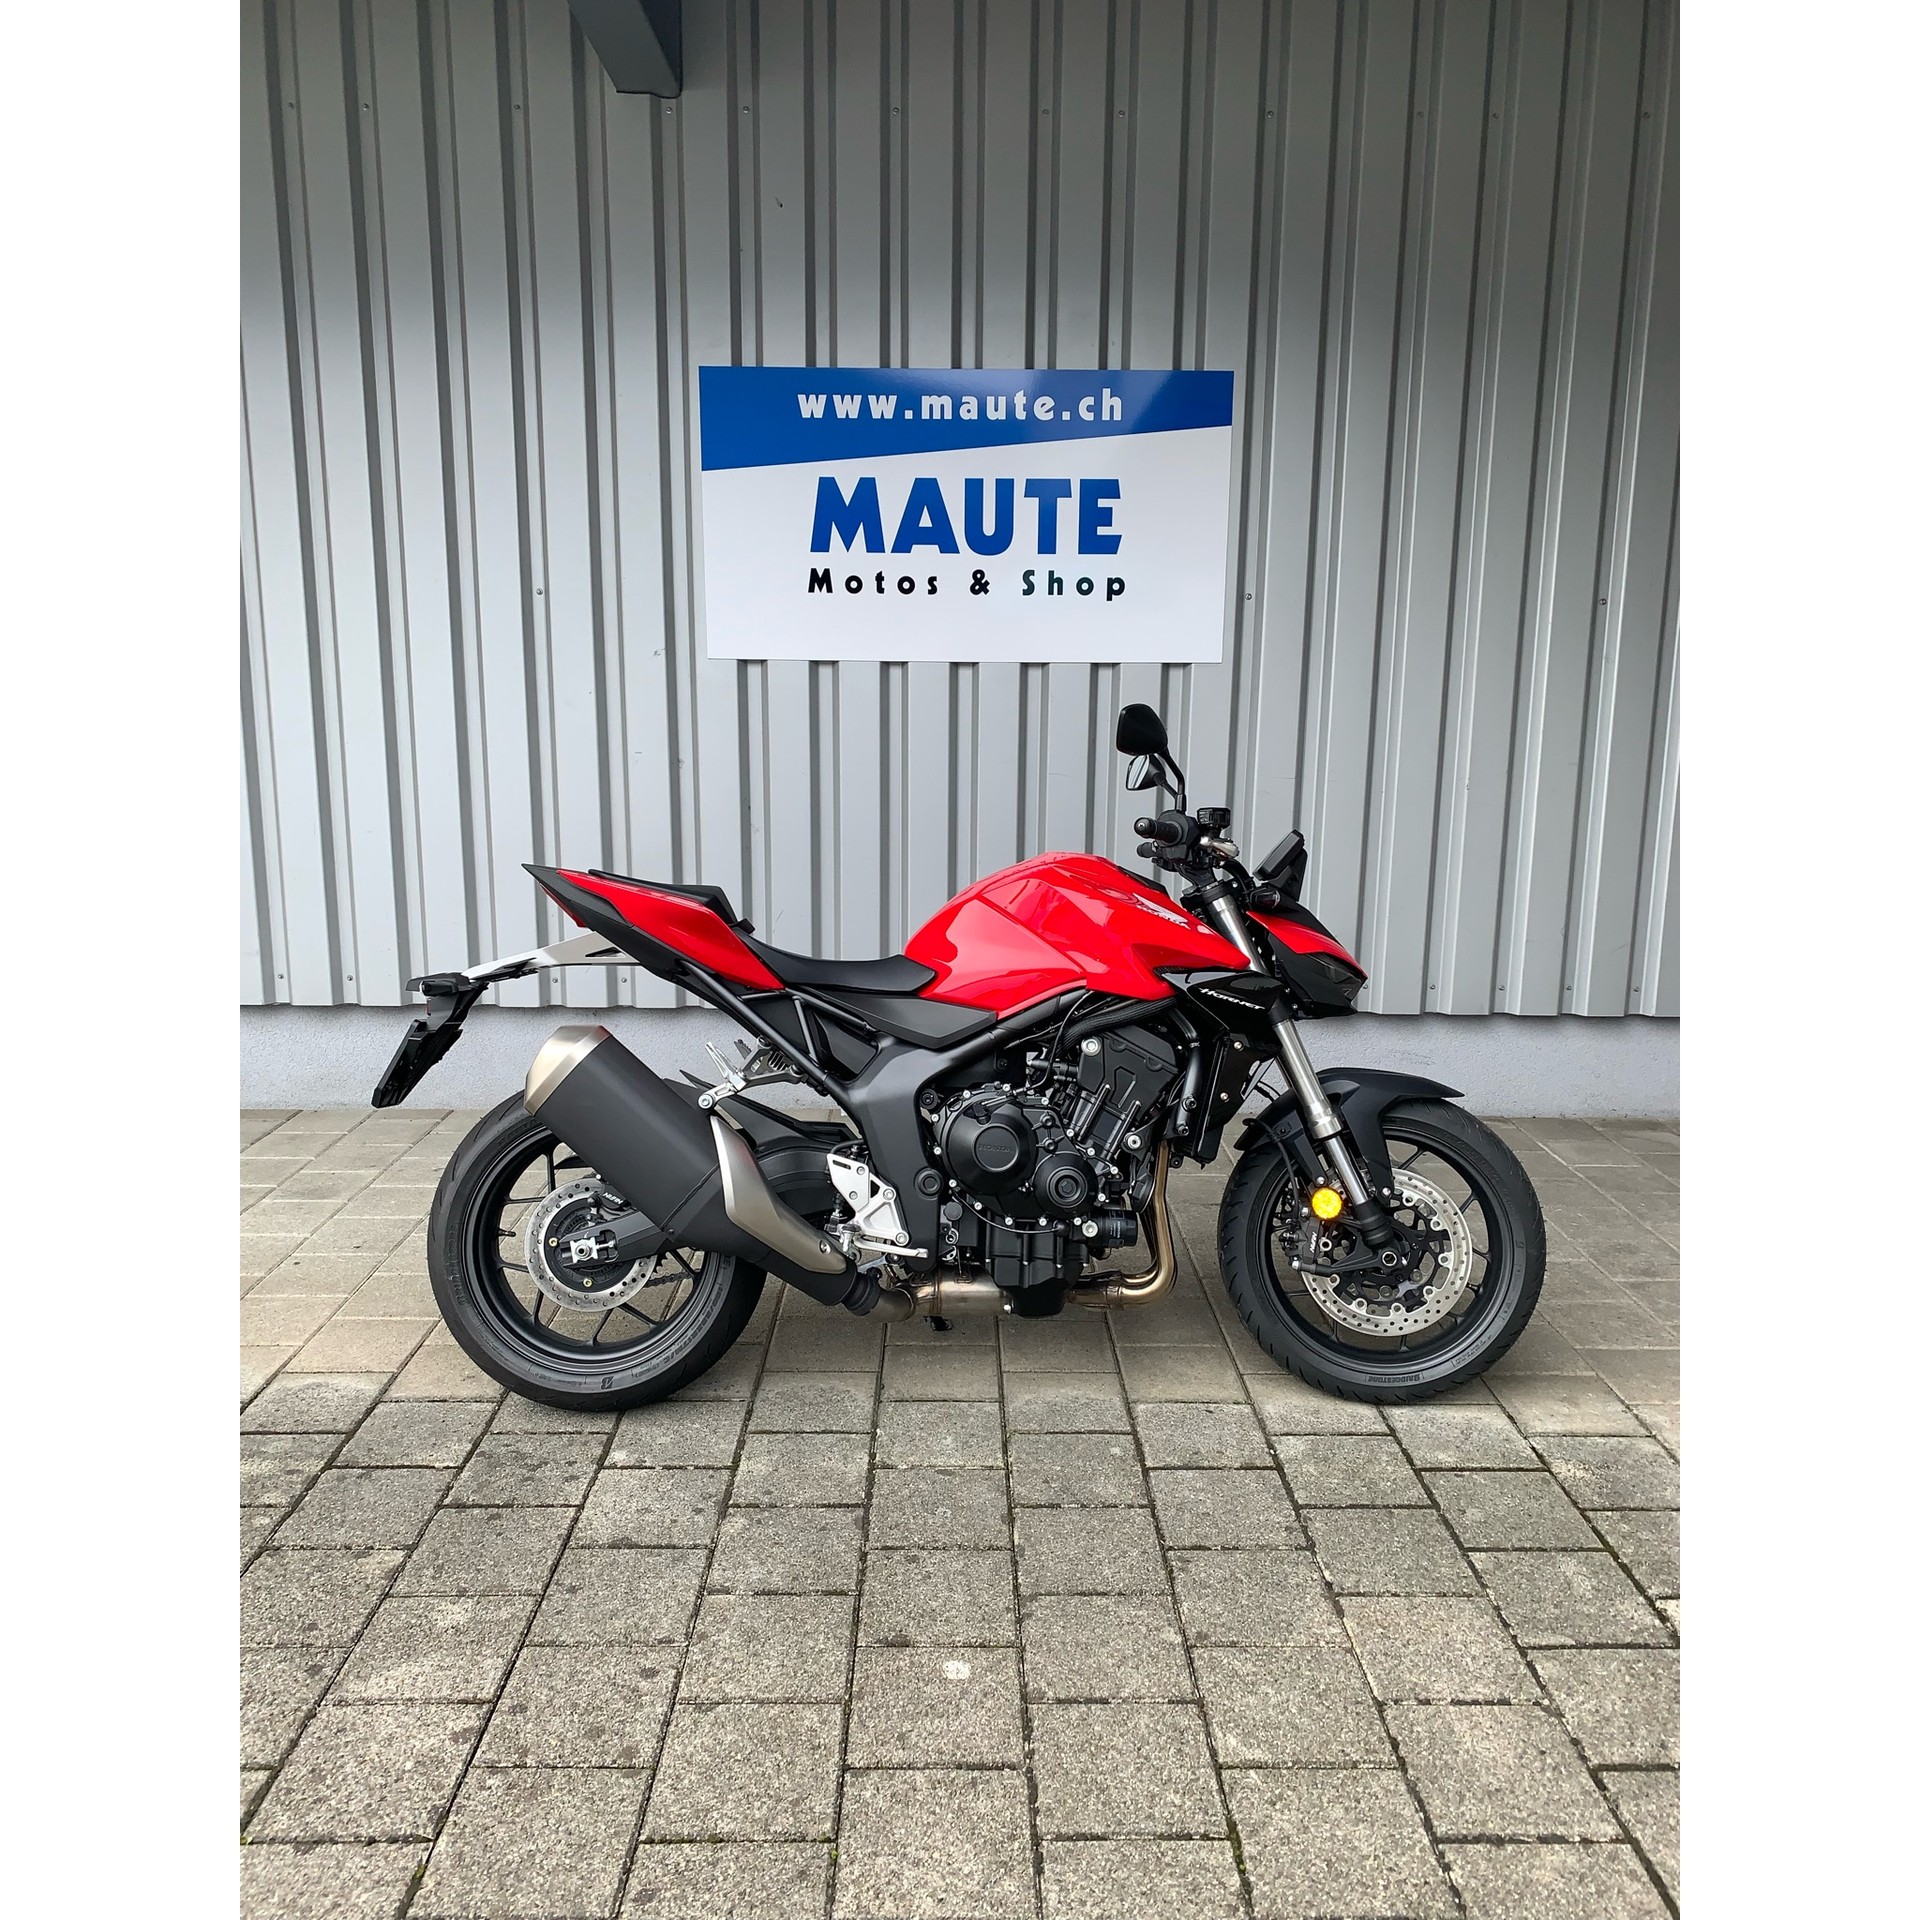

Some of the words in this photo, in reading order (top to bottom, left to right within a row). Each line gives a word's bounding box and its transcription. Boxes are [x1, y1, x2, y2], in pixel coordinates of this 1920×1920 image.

[797, 388, 1122, 421] www.maute.ch
[810, 476, 1123, 556] MAUTE
[808, 567, 938, 596] Motos
[969, 569, 991, 596] &
[1022, 569, 1126, 602] Shop
